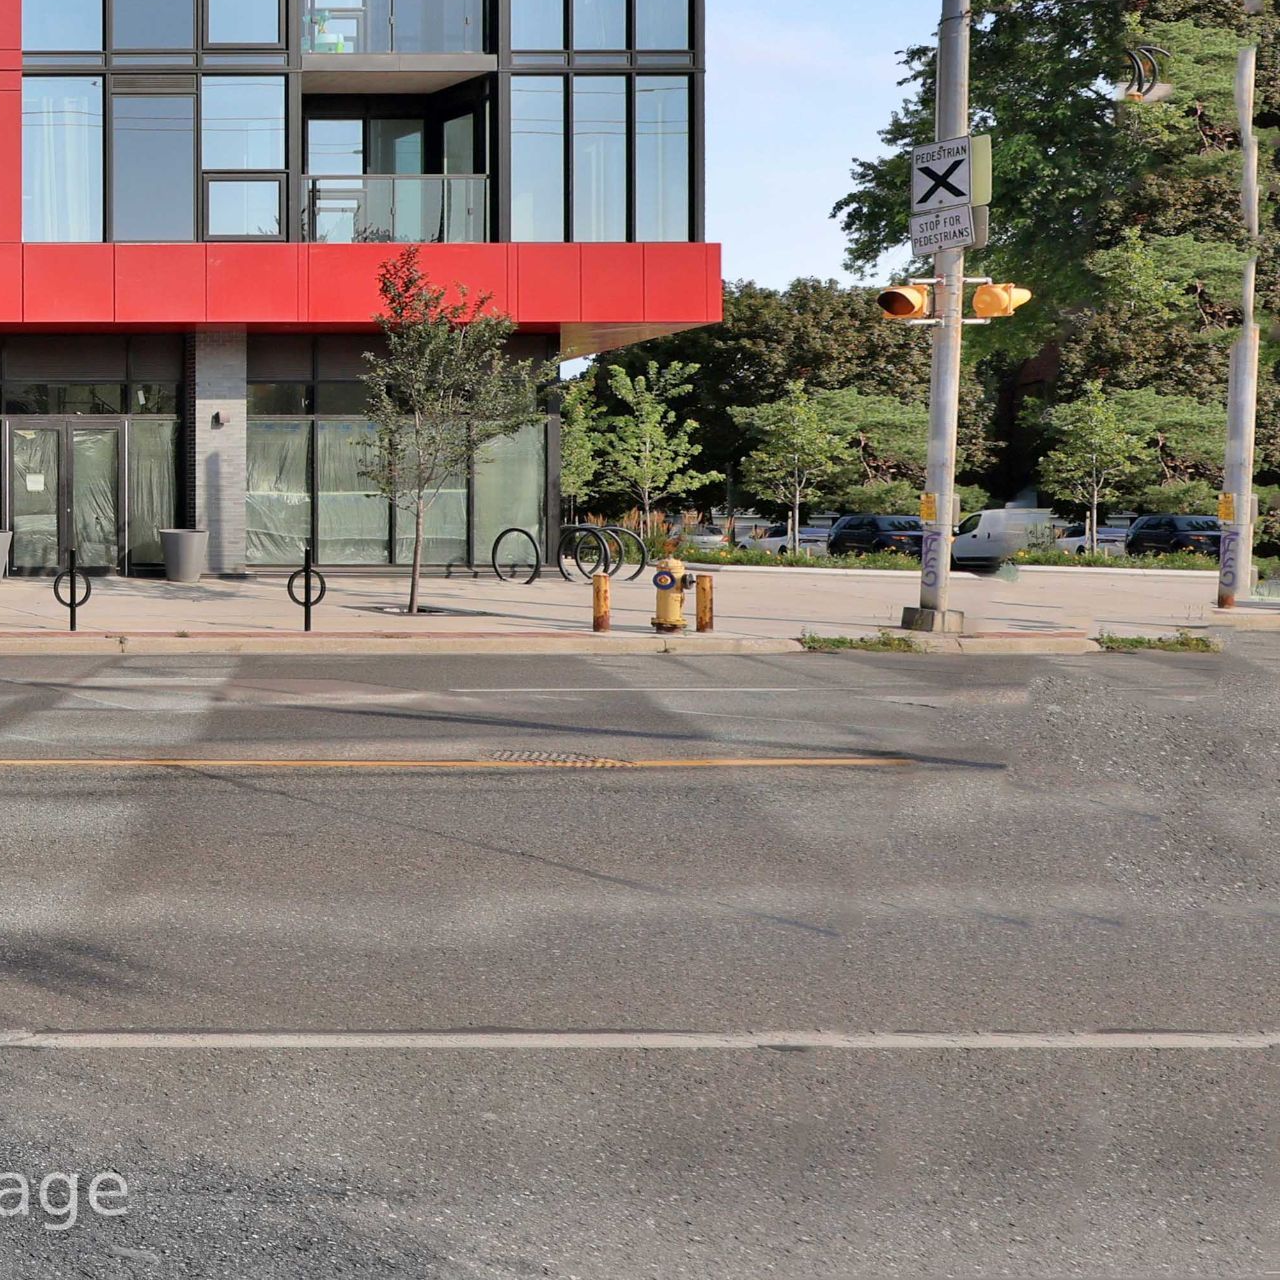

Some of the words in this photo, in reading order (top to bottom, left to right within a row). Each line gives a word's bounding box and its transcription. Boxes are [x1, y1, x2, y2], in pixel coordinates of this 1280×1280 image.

[915, 144, 968, 165] PEDESTRIAN
[919, 218, 940, 233] STOP
[943, 215, 961, 228] FOR
[913, 227, 970, 248] PEDESTRIANS
